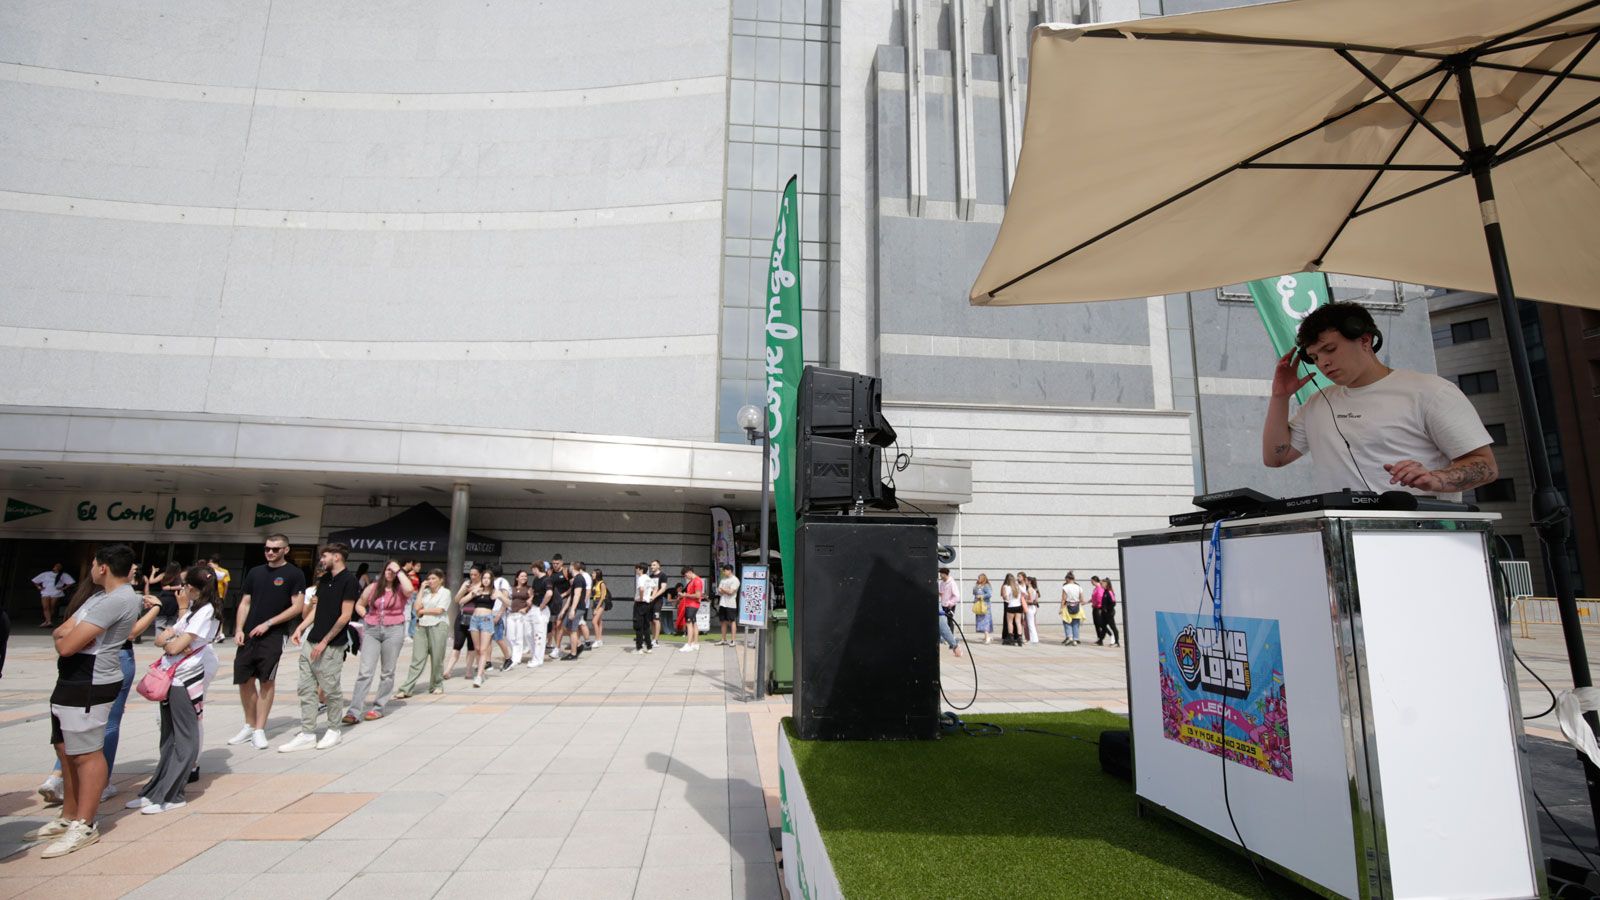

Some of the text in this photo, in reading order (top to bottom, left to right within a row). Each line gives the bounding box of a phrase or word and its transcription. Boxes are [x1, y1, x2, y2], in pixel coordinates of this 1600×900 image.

[77, 497, 234, 530] El Corte Inglés
[350, 538, 436, 551] VIVATICKET
[1200, 655, 1246, 691] LOCO
[1201, 700, 1231, 719] LEÓN
[1207, 732, 1214, 742] DE
[1236, 741, 1256, 755] 2025
